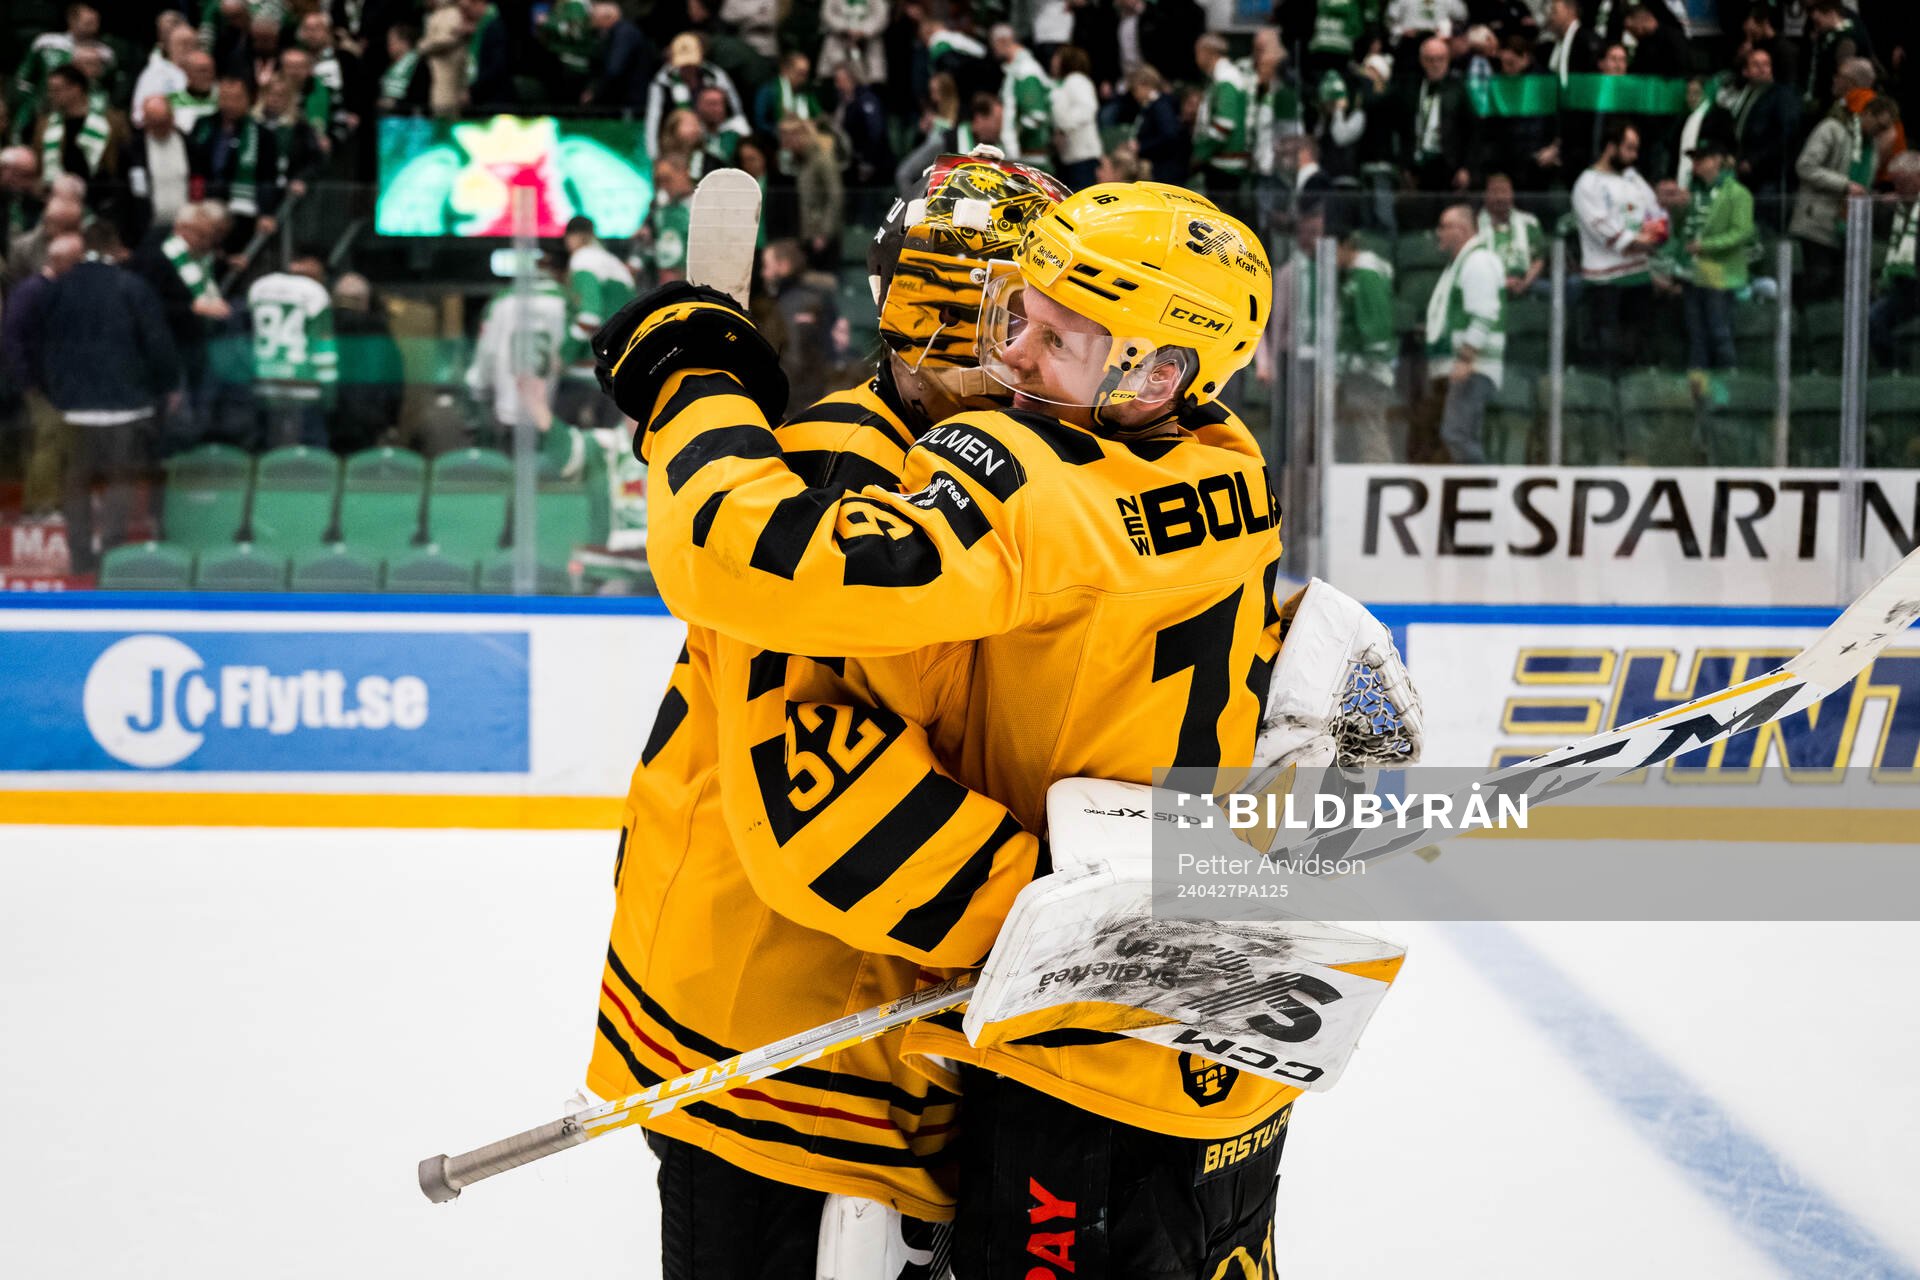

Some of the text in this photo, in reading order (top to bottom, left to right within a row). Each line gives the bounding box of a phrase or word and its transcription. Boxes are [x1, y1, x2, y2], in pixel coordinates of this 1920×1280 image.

[1031, 253, 1046, 269] Kraft
[1235, 255, 1258, 277] Kraft
[1170, 307, 1224, 331] CCM
[914, 426, 1005, 477] OLMEN
[1115, 494, 1151, 557] NEW
[220, 665, 430, 735] Flytt.se
[784, 701, 887, 812] 32
[1172, 1028, 1325, 1083] CCM
